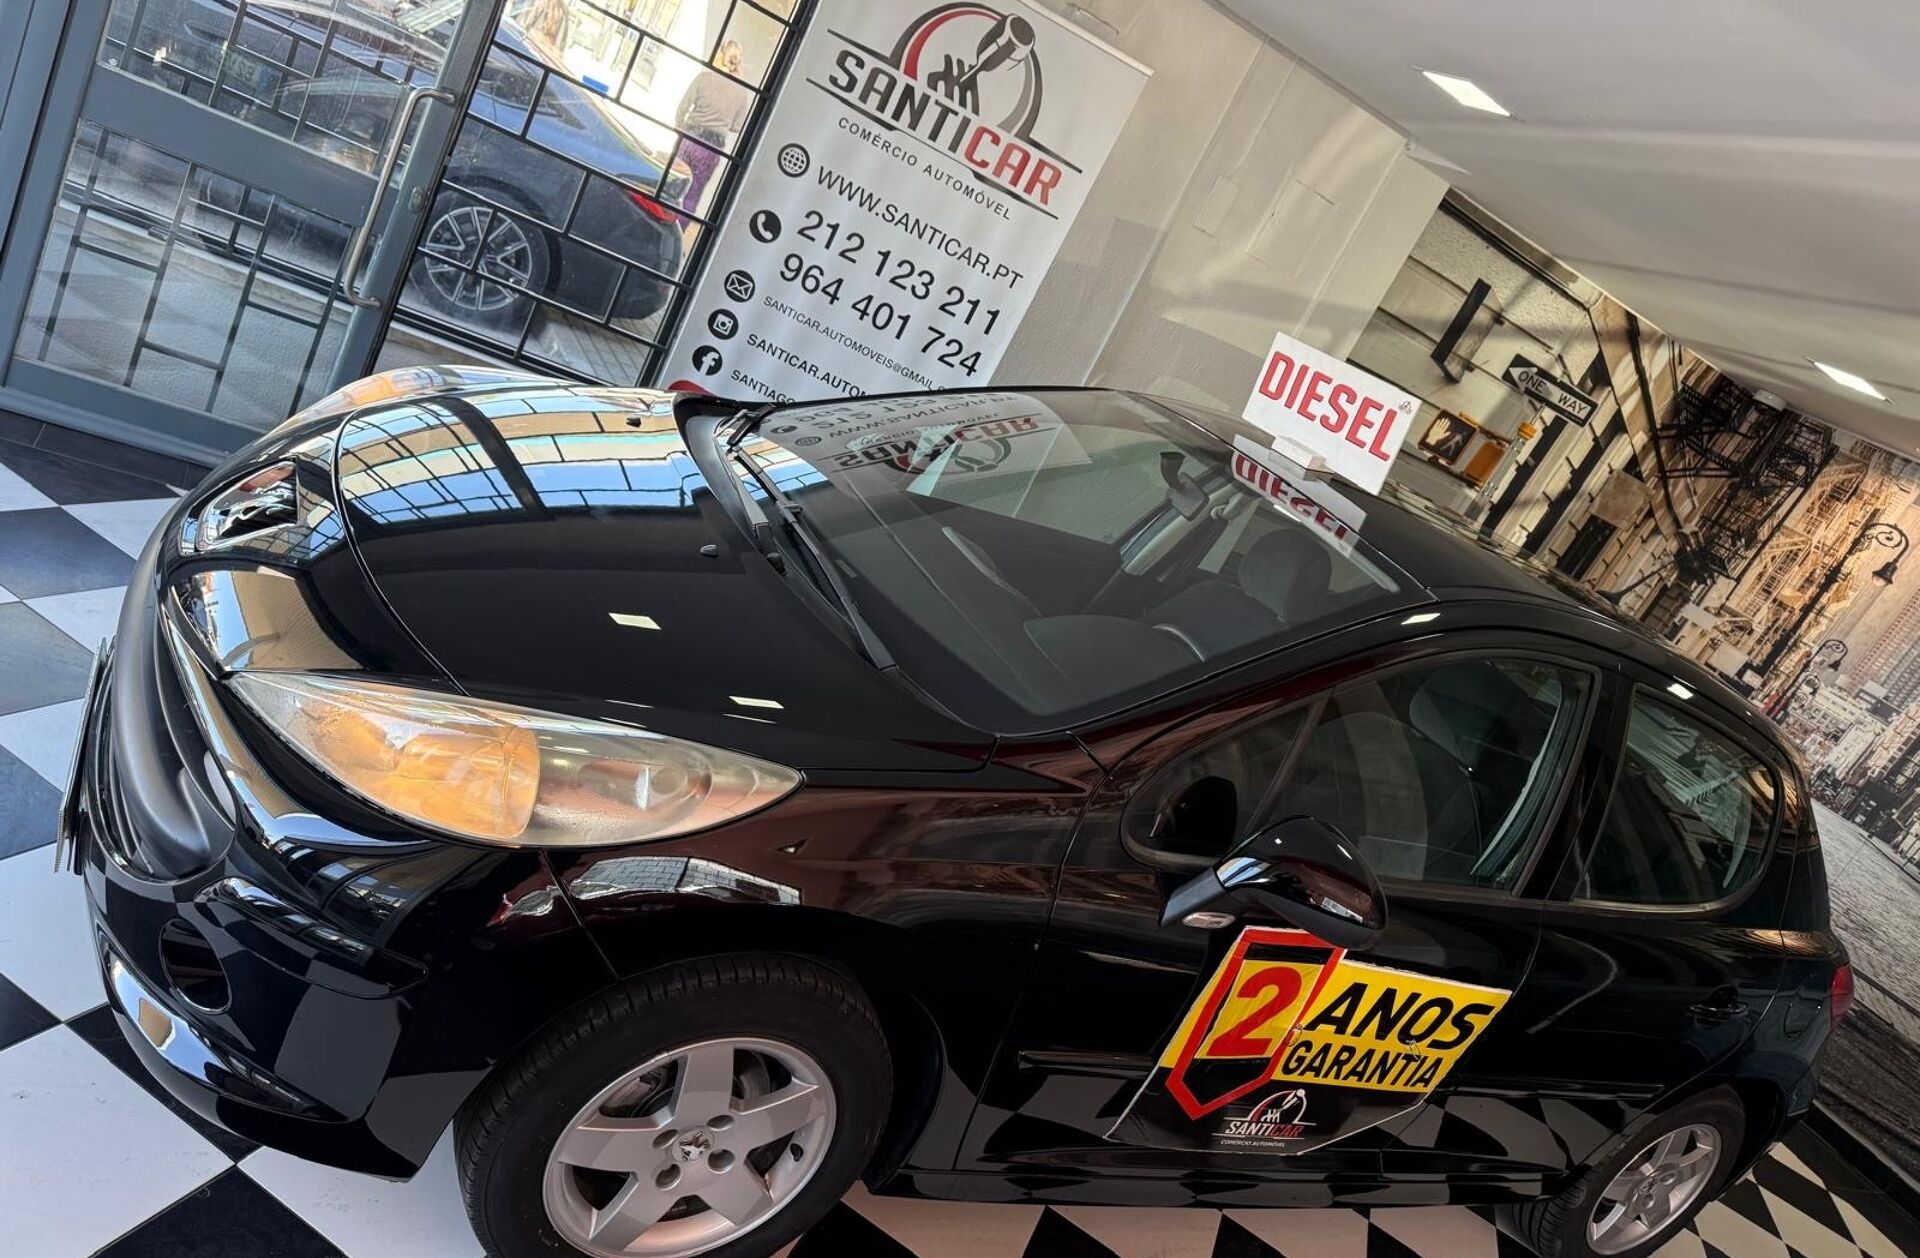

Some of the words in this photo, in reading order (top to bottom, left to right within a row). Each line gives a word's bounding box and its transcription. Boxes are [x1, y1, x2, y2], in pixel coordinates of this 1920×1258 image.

[829, 49, 1062, 206] SANTICAR
[838, 117, 918, 166] COMÉRCIO
[922, 164, 1011, 220] AUTOMÓVEL
[797, 210, 865, 264] 212
[874, 250, 935, 300] 123
[938, 286, 1001, 336] 211
[818, 166, 1024, 290] WWW.SANTICAR.PT
[780, 253, 845, 305] 964
[851, 294, 911, 340] 401
[920, 326, 982, 377] 724
[1258, 351, 1398, 462] DIESEL
[1518, 370, 1547, 394] ONE
[1557, 393, 1588, 415] WAY
[1206, 966, 1302, 1058] 2
[1303, 981, 1496, 1050] ANOS
[1281, 1040, 1444, 1088] GARANTIA
[1225, 1121, 1305, 1137] SANTICAR
